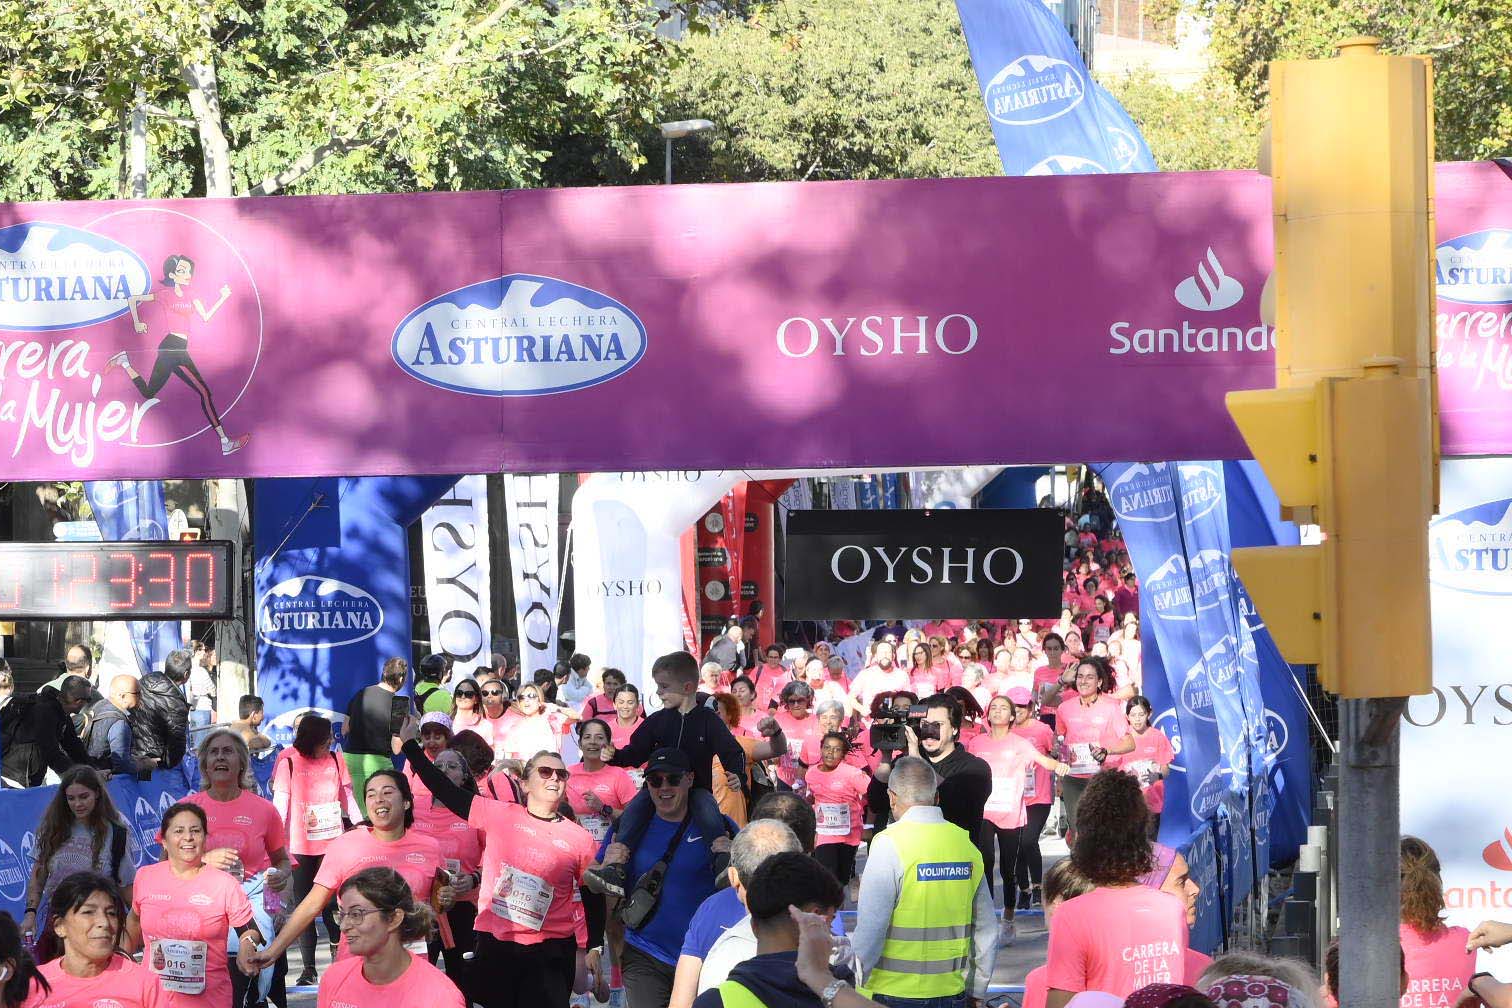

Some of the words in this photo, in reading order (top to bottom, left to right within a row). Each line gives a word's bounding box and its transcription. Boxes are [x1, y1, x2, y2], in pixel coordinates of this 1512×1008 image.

[450, 316, 529, 329] CENTRAL
[537, 315, 619, 328] LECHERA
[412, 321, 627, 366] ASTURIANA
[776, 313, 979, 358] OYSHO
[1109, 321, 1276, 354] Santand
[12, 374, 161, 467] Mujer
[831, 545, 1024, 586] OYSHO
[274, 601, 317, 609] CENTRAL
[261, 606, 375, 632] ASTURIANA
[918, 865, 970, 879] VOLUNTARIS
[1122, 940, 1180, 961] CARRERA
[166, 959, 186, 969] 016
[1134, 960, 1149, 974] DE
[1153, 958, 1169, 972] LA
[1400, 995, 1423, 1008] DE
[1429, 993, 1449, 1006] LA
